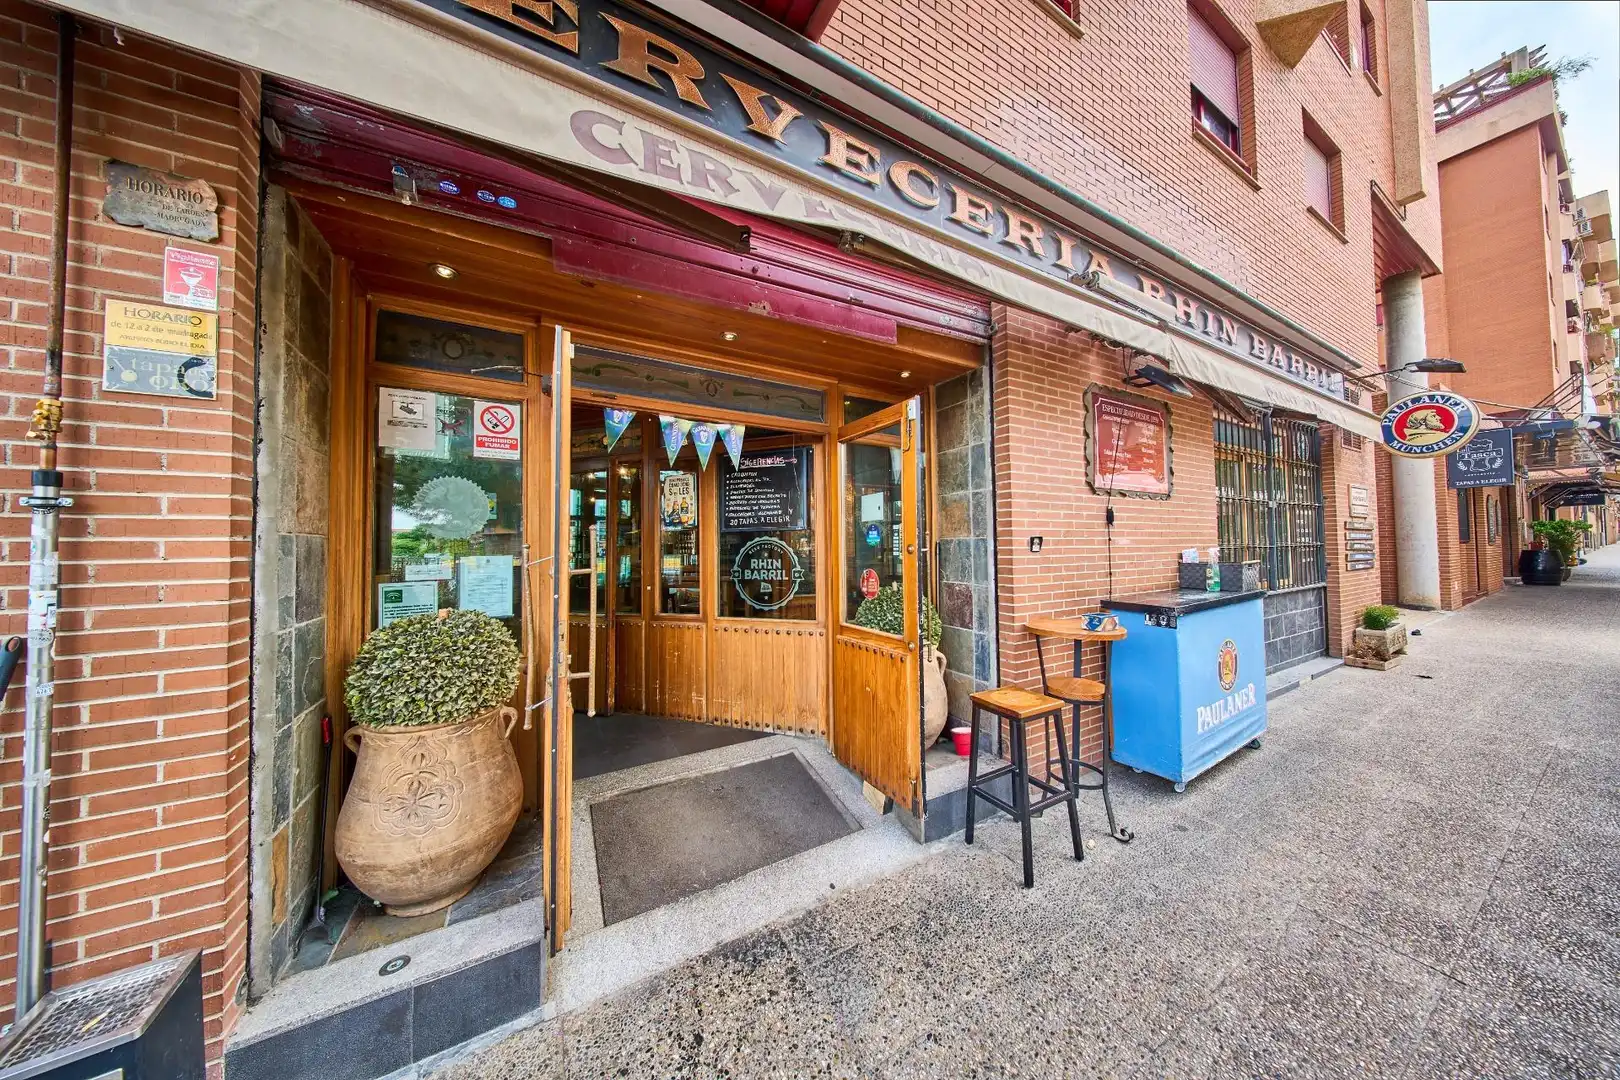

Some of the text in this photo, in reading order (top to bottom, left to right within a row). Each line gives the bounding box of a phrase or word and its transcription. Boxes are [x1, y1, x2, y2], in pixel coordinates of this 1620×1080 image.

[126, 177, 203, 204] HORARIO
[124, 306, 203, 326] HORARIO
[1382, 395, 1468, 426] PAULANER
[477, 436, 517, 444] PROHIBIDO
[484, 441, 511, 449] FUMAR
[739, 517, 758, 525] TAPAS
[750, 558, 782, 569] RHIN
[744, 569, 789, 581] BARRIL
[1196, 682, 1257, 735] PAULANER
